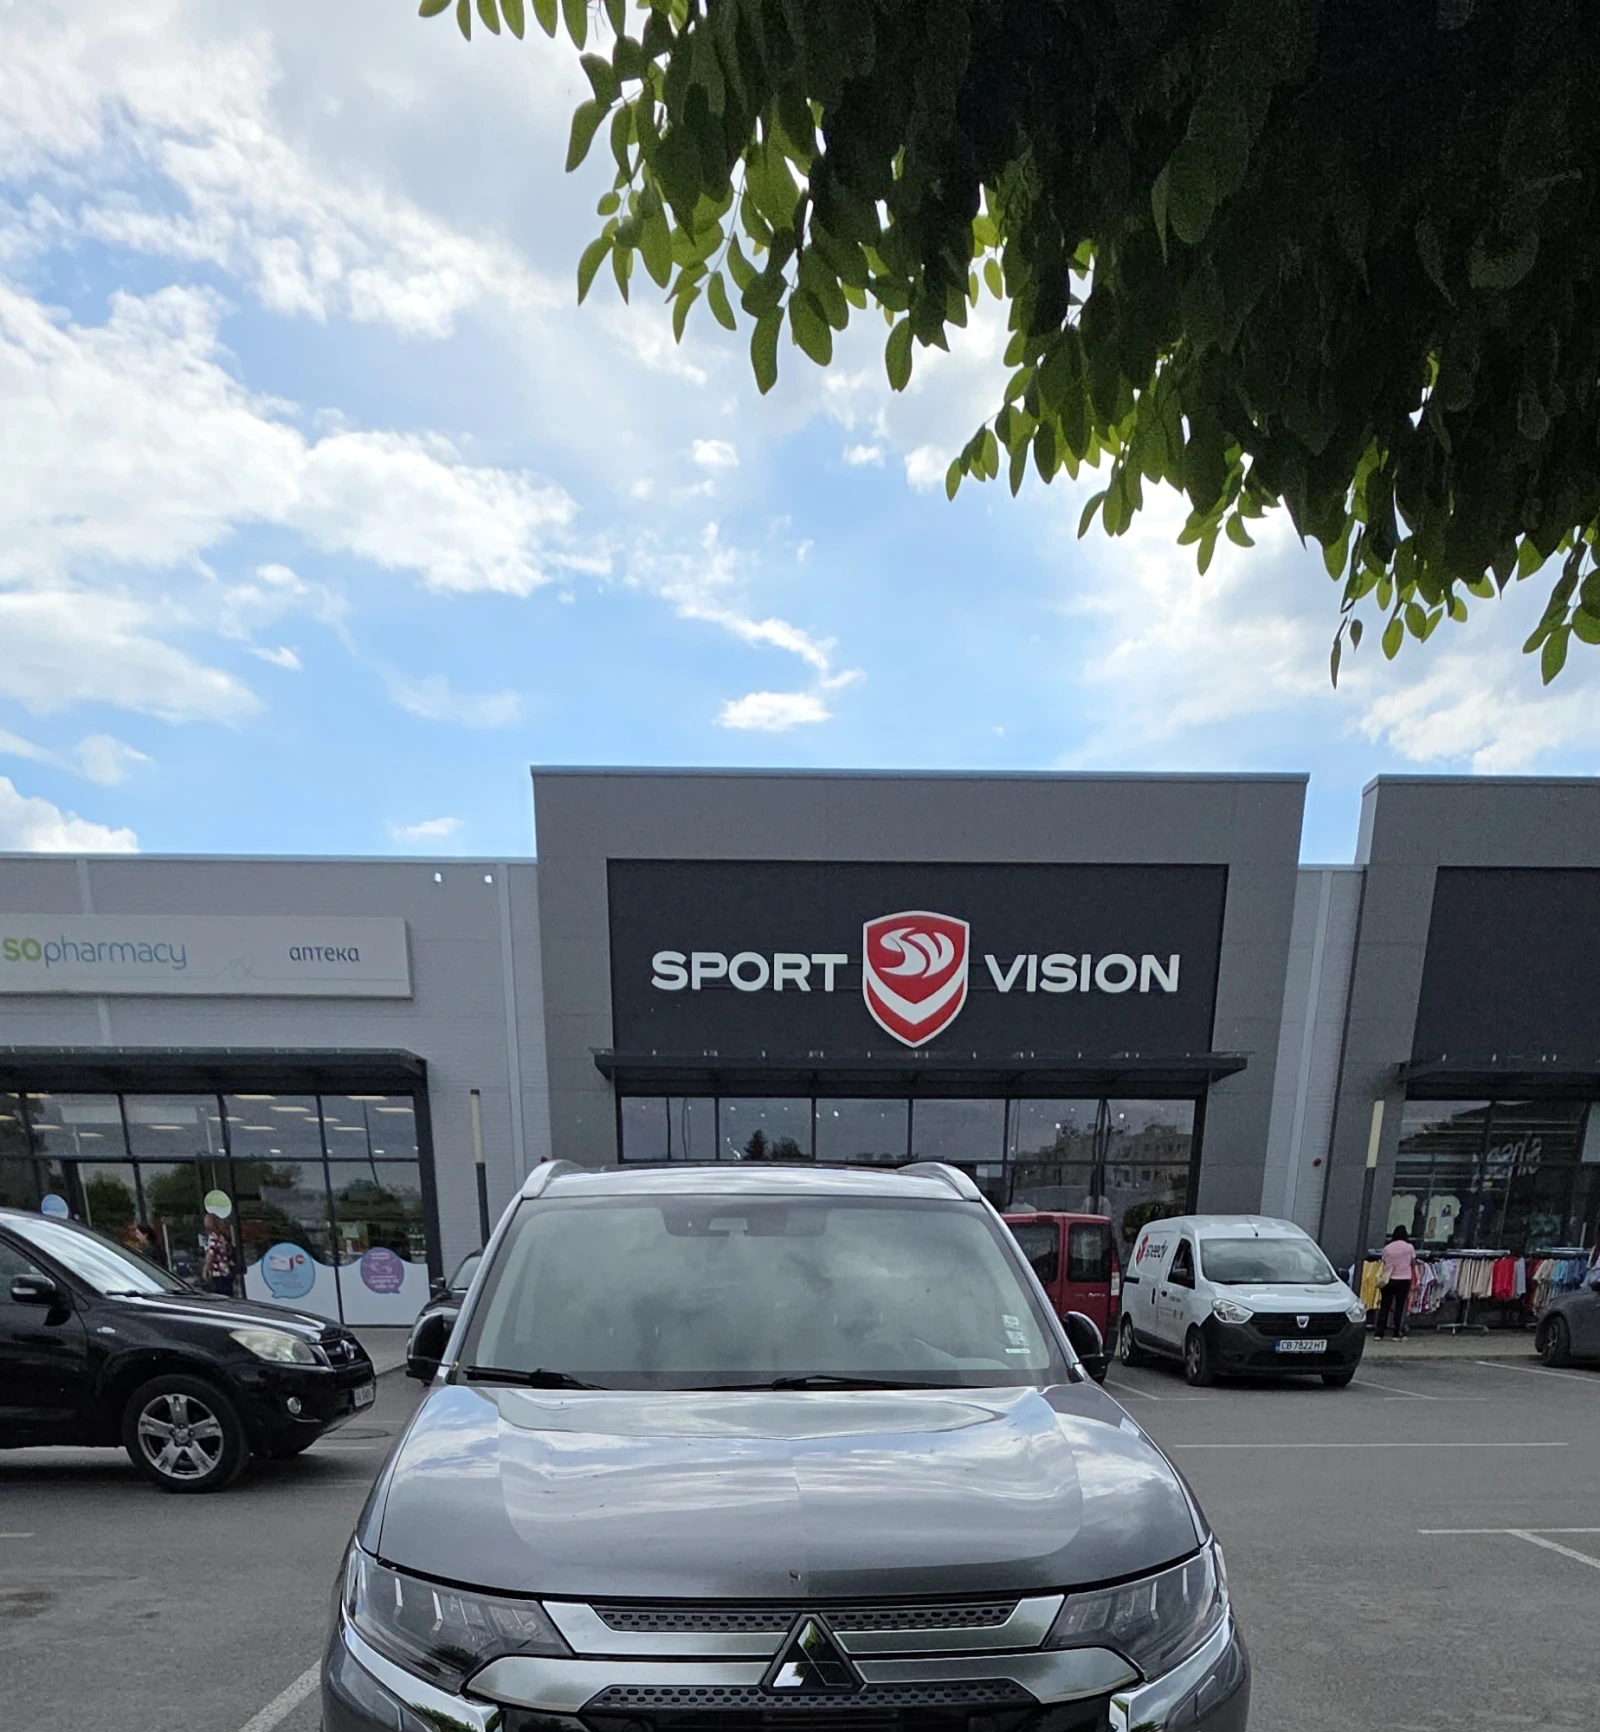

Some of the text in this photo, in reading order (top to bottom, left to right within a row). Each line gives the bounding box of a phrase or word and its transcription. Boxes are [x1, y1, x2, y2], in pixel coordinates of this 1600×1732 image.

[2, 934, 187, 970] sopharmacy
[289, 946, 361, 963] аптека
[651, 950, 1180, 993] SPORT VISION
